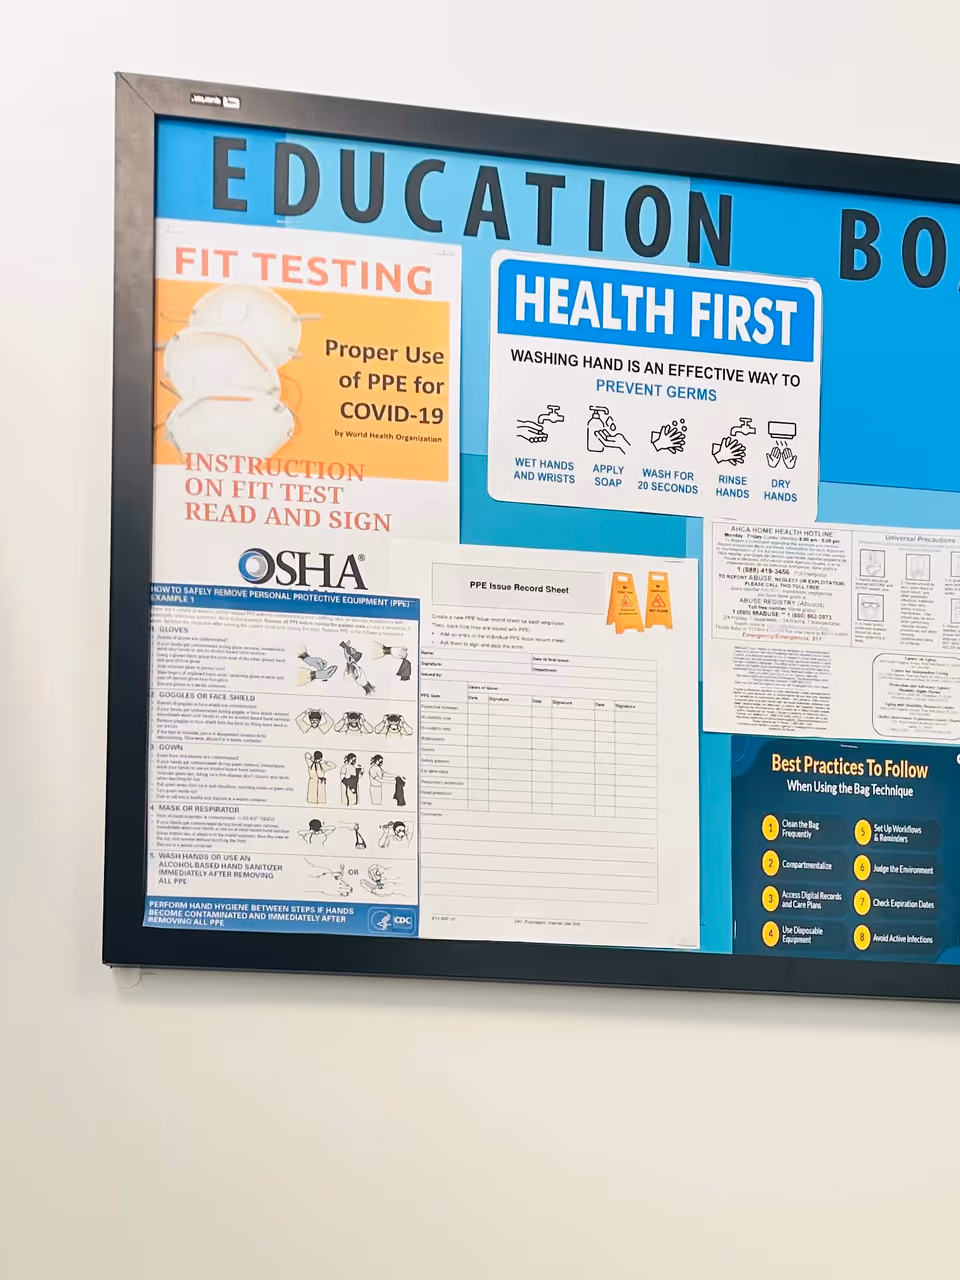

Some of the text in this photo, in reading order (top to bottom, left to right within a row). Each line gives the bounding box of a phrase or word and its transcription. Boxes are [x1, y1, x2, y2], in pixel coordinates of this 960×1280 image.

[212, 136, 732, 267] EDUCATION
[176, 247, 431, 294] FIT TESTING
[516, 275, 798, 344] HEALTH FIRST
[326, 339, 443, 364] Proper Use
[511, 349, 800, 386] WASHING HAND IS AN EFFECTIVE WAY TO
[339, 371, 444, 393] of PPE for
[596, 379, 716, 401] PREVENT GERMS
[340, 402, 442, 424] COVID-19
[395, 434, 441, 442] Organization
[184, 451, 365, 482] INSTRUCTION
[515, 457, 573, 470] WET HANDS
[514, 470, 574, 483] AND WRISTS
[592, 464, 624, 477] APPLY
[642, 468, 693, 480] WASH FOR
[594, 476, 622, 486] SOAP
[718, 474, 746, 485] RINSE
[771, 479, 790, 488] DRY
[185, 477, 343, 504] ON FIT TEST
[638, 480, 698, 494] 20 SECONDS
[716, 488, 749, 498] HANDS
[764, 491, 796, 502] HANDS
[185, 502, 390, 531] READ AND SIGN
[489, 582, 511, 590] Issue
[514, 583, 543, 592] Record
[545, 585, 568, 593] Sheet
[771, 753, 928, 778] Best Practices To Follow
[786, 779, 912, 798] When Using the Bag Technique
[781, 819, 820, 830] Clean the Bag
[781, 828, 812, 838] Frequently
[781, 859, 832, 869] Compartmentalize
[150, 901, 187, 910] PERFORM
[190, 902, 212, 910] HAND
[215, 904, 248, 912] HYGIENE
[251, 904, 288, 912] BETWEEN
[872, 898, 935, 909] Check Expiration Dates
[148, 916, 224, 926] REMOVING ALL PPE
[149, 909, 182, 918] BECOME
[184, 910, 248, 920] CONTAMINATED
[250, 912, 266, 920] AND
[268, 913, 321, 922] IMMEDIATELY
[395, 916, 412, 924] CDC
[872, 933, 934, 944] Avoid Active Infections
